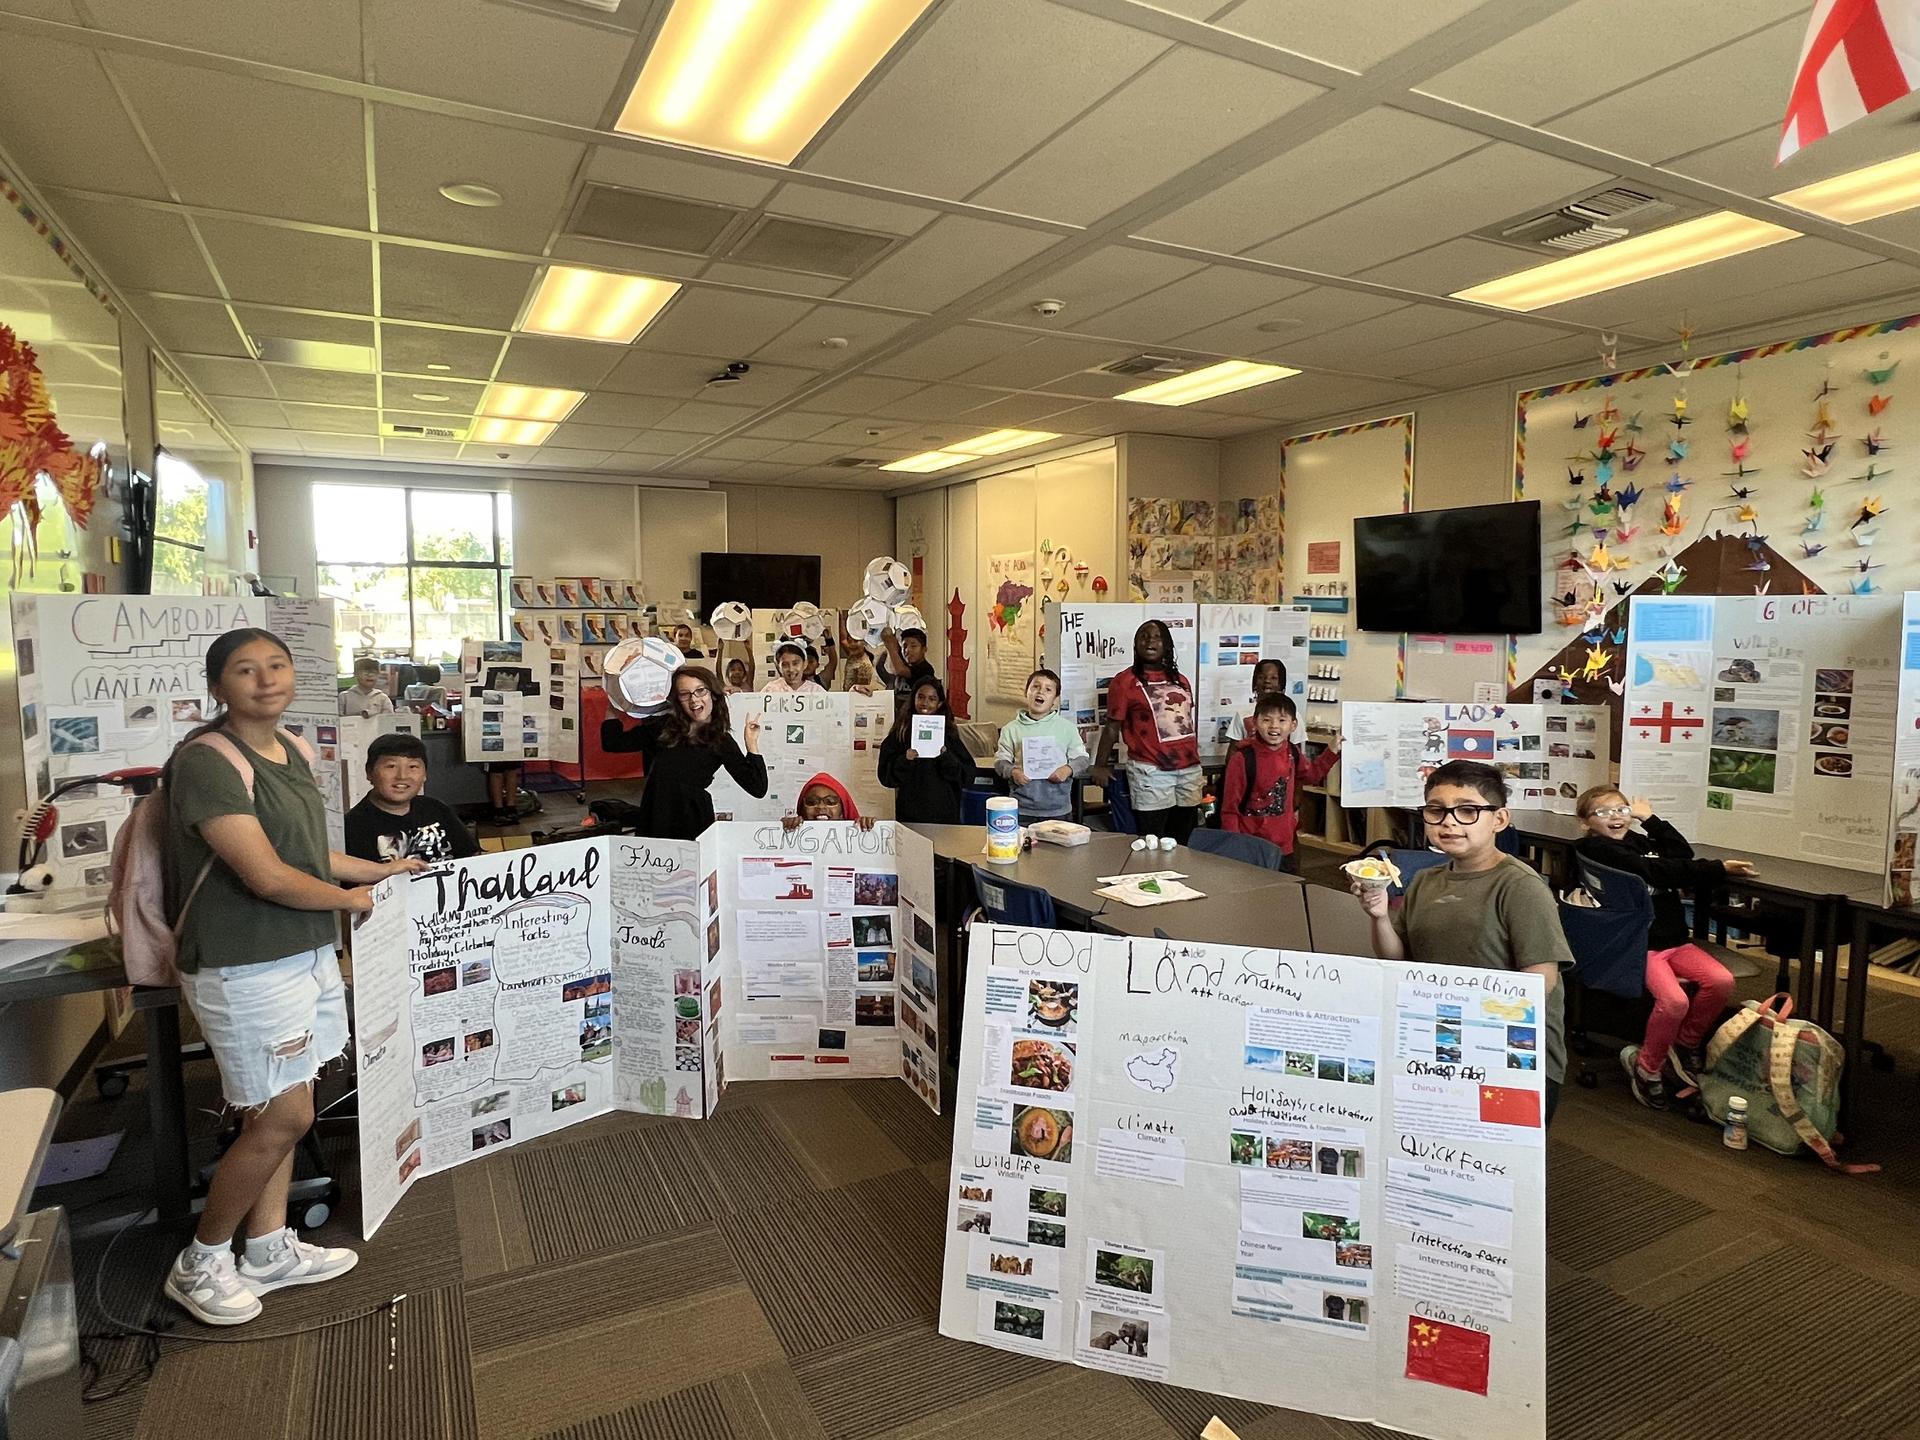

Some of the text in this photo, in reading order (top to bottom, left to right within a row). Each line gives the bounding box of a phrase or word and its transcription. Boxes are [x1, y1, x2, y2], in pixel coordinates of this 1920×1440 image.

[72, 600, 249, 646] CAMBODIA
[1060, 611, 1084, 634] THE
[620, 844, 681, 873] Flag
[410, 846, 601, 916] Thailand
[503, 907, 578, 930] Interesting
[1242, 949, 1342, 985] China
[1413, 989, 1470, 1002] Map of China
[1260, 1006, 1305, 1018] Landmarks
[1314, 1012, 1361, 1024] Attractions
[1137, 1133, 1167, 1144] Climate
[998, 1169, 1025, 1180] Wildlife
[1424, 1163, 1476, 1182] Quick Facts
[1240, 1240, 1282, 1251] Chinese New
[1419, 1253, 1496, 1277] Interesting Facts
